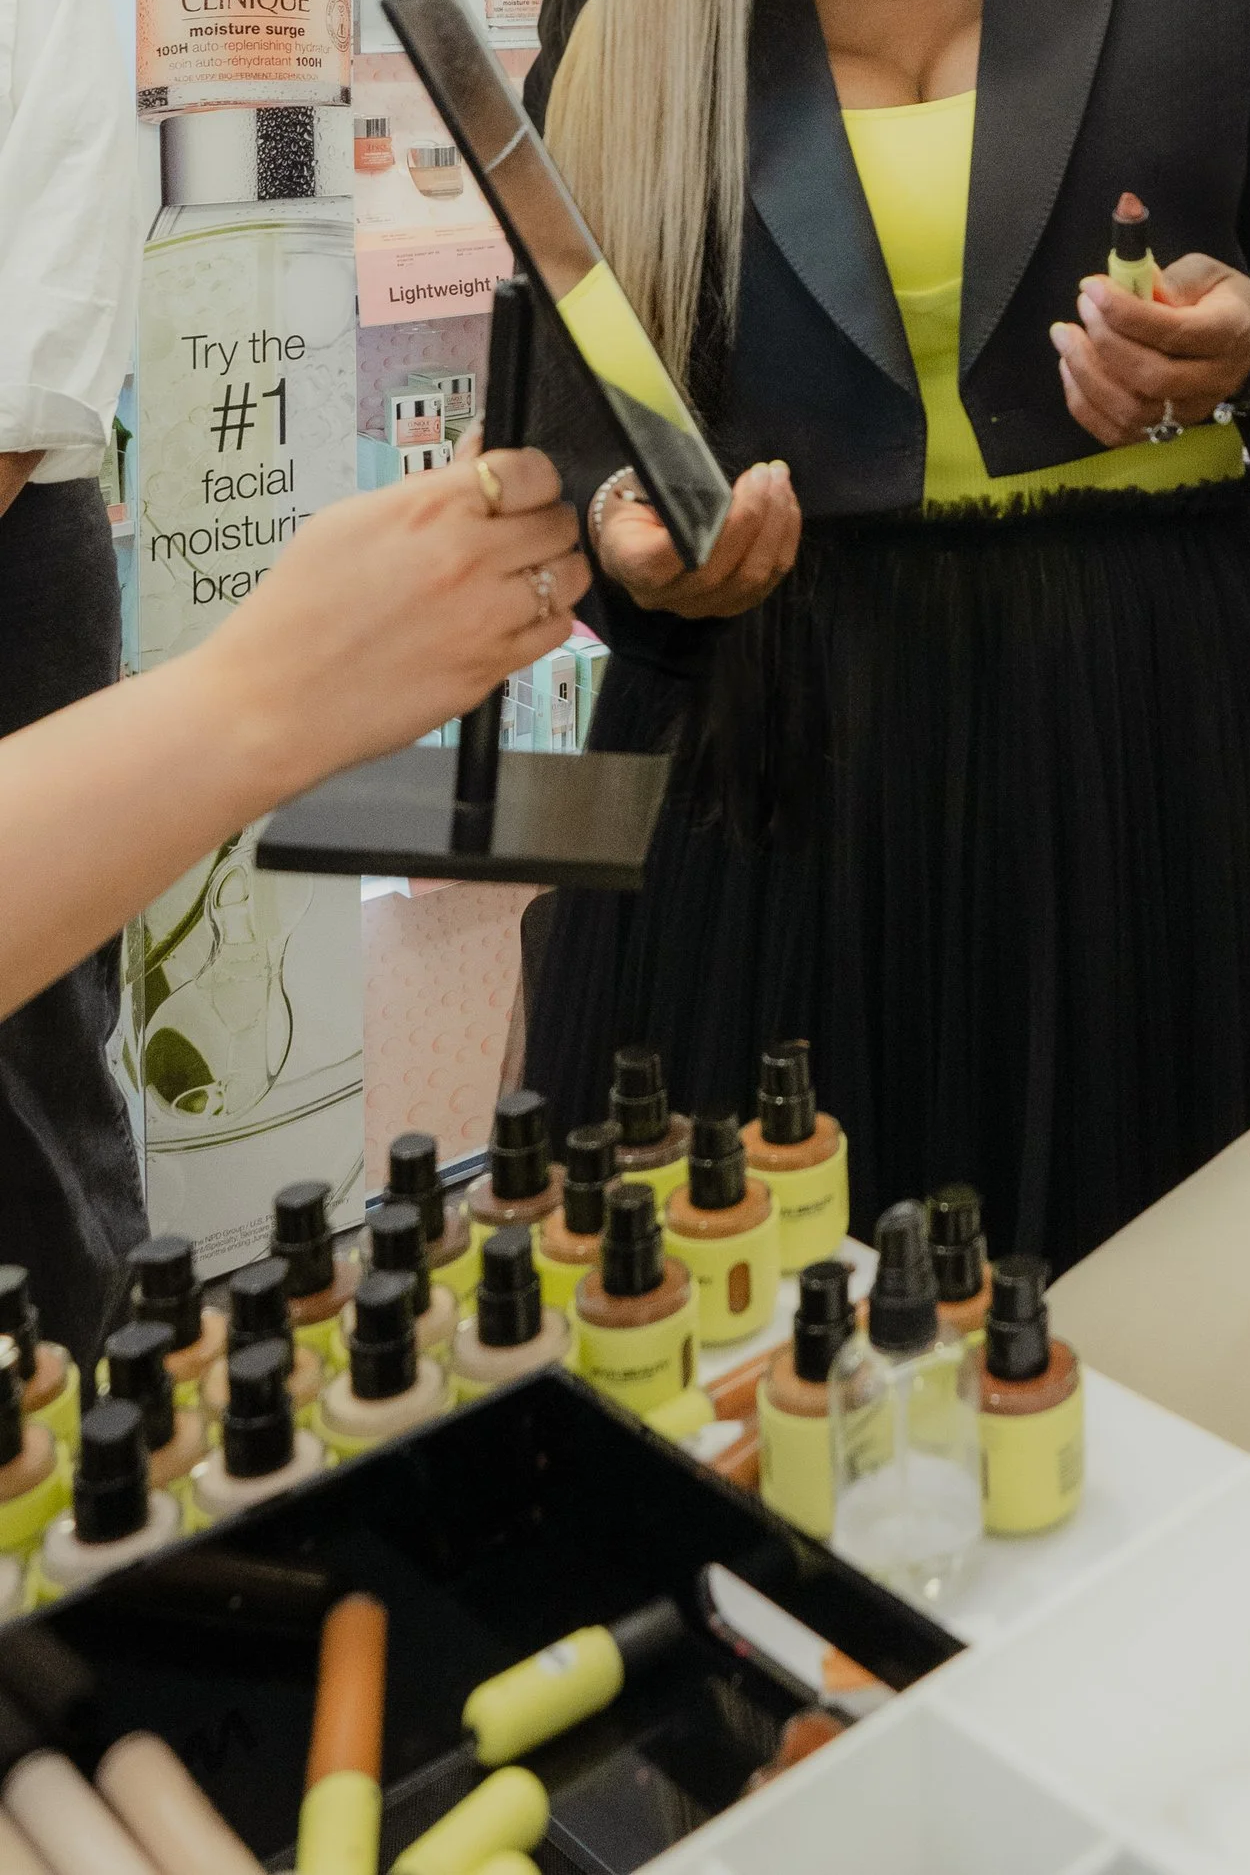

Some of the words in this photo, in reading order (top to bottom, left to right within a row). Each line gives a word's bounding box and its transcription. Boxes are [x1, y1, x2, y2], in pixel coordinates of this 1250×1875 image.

[156, 43, 189, 57] 100H
[192, 39, 292, 54] auto-replenishing
[189, 23, 260, 38] moisture
[265, 24, 305, 39] surge
[168, 58, 192, 71] soin
[195, 54, 292, 69] auto-réhydratant
[295, 56, 322, 68] 100H
[389, 277, 492, 304] Lightweight
[181, 334, 239, 376] Try
[248, 329, 306, 364] the
[210, 377, 287, 453] #1
[201, 458, 295, 504] facial
[150, 506, 316, 563] moisturi
